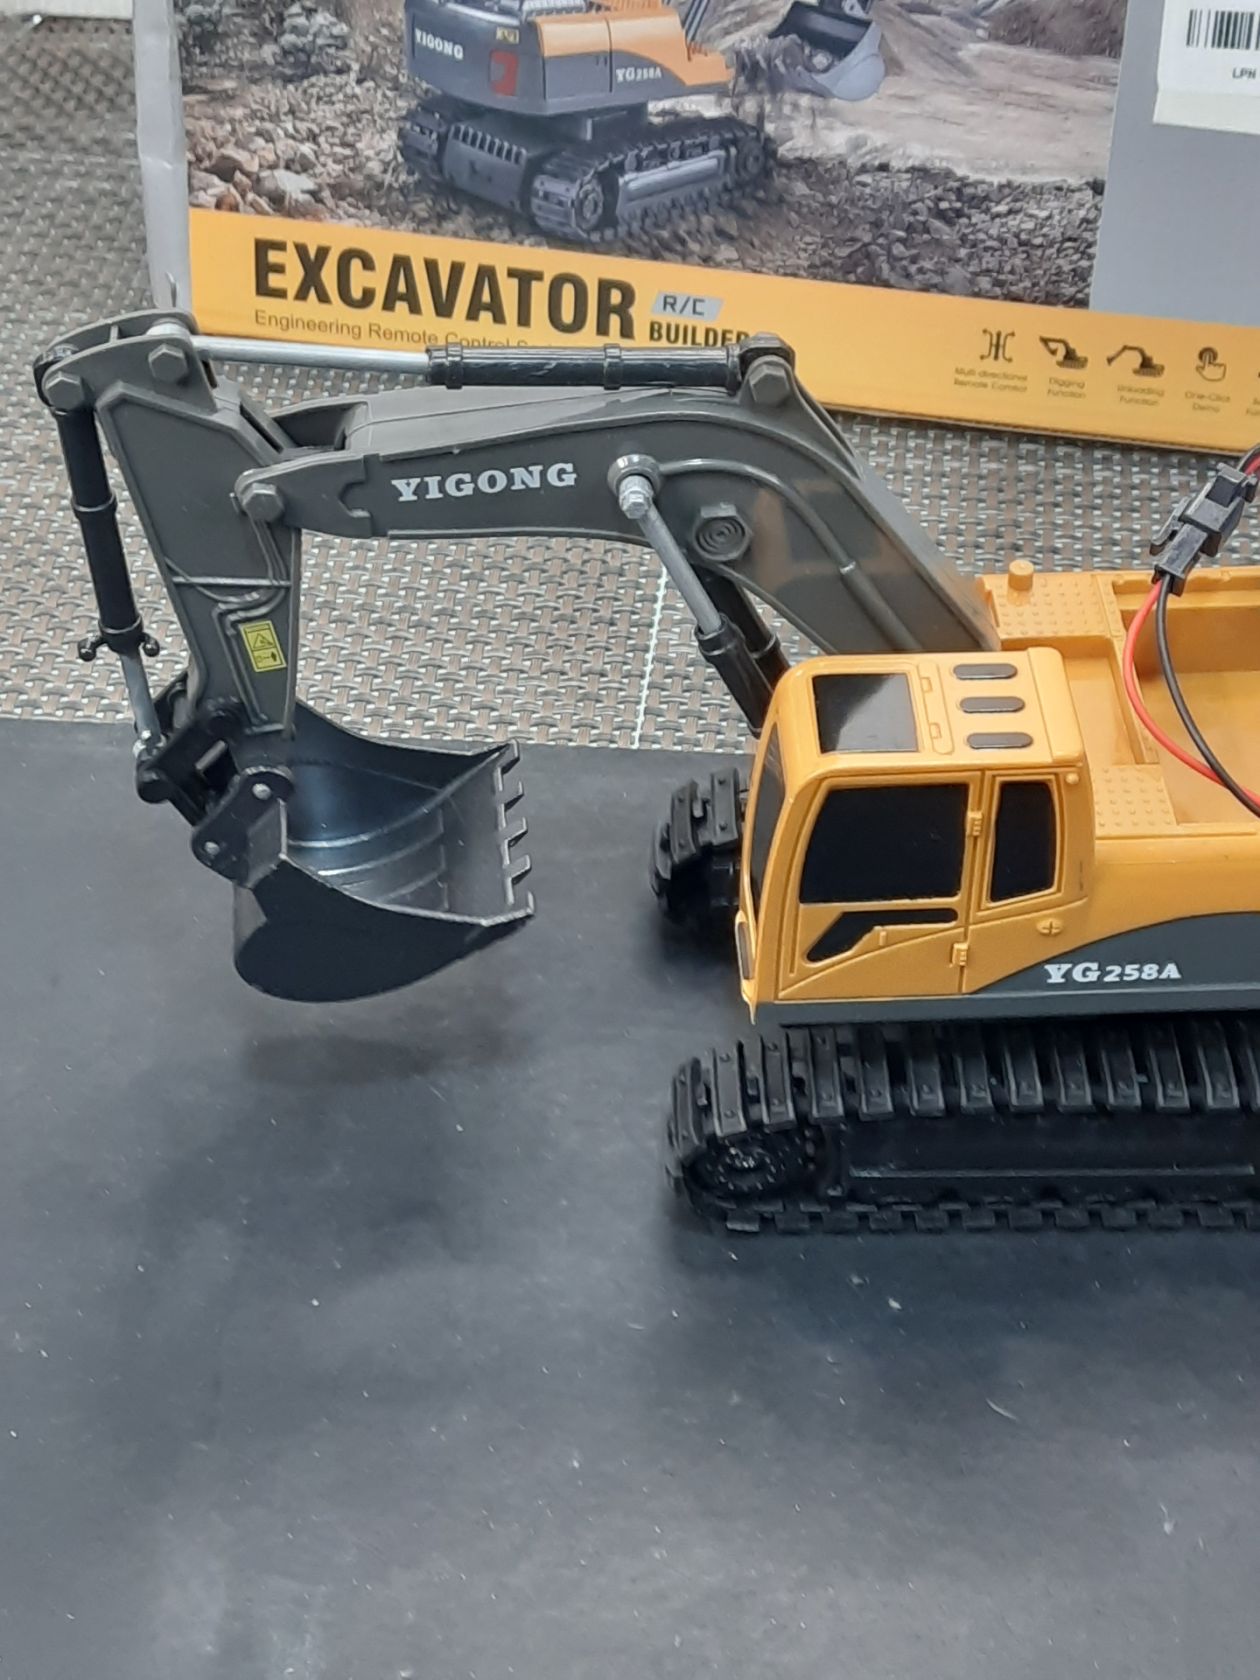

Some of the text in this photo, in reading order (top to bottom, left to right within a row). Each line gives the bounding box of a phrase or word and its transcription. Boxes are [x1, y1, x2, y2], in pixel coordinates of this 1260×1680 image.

[1232, 66, 1258, 80] LPN
[254, 238, 637, 341] EXCAVATOR
[661, 294, 706, 317] R/C
[254, 309, 363, 341] Engineering
[367, 322, 439, 344] Remote
[391, 462, 578, 502] YIGONG
[1044, 962, 1182, 984] YG258A
